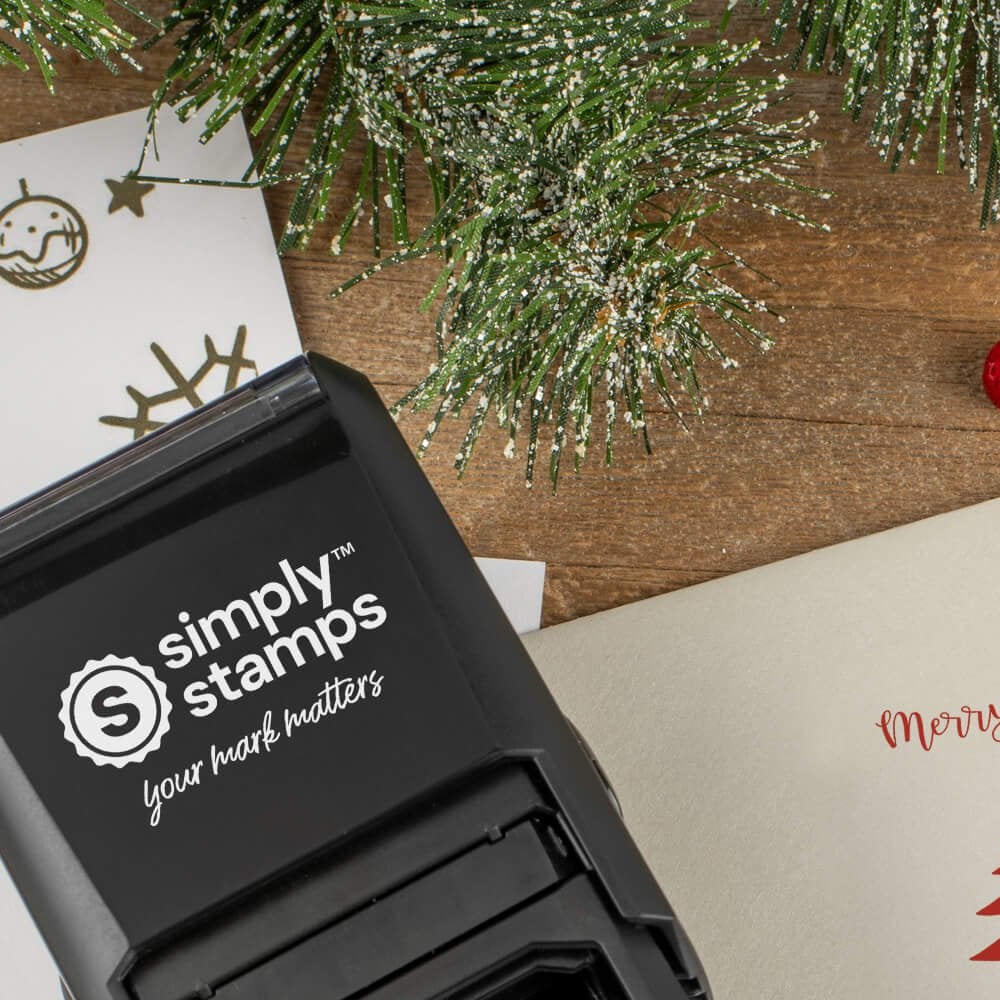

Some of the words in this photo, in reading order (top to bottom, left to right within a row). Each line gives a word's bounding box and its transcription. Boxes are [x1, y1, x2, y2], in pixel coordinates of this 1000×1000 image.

[158, 553, 335, 670] simply
[183, 593, 388, 718] stamps
[143, 759, 204, 827] your
[210, 710, 281, 775] mark
[284, 669, 385, 738] matters
